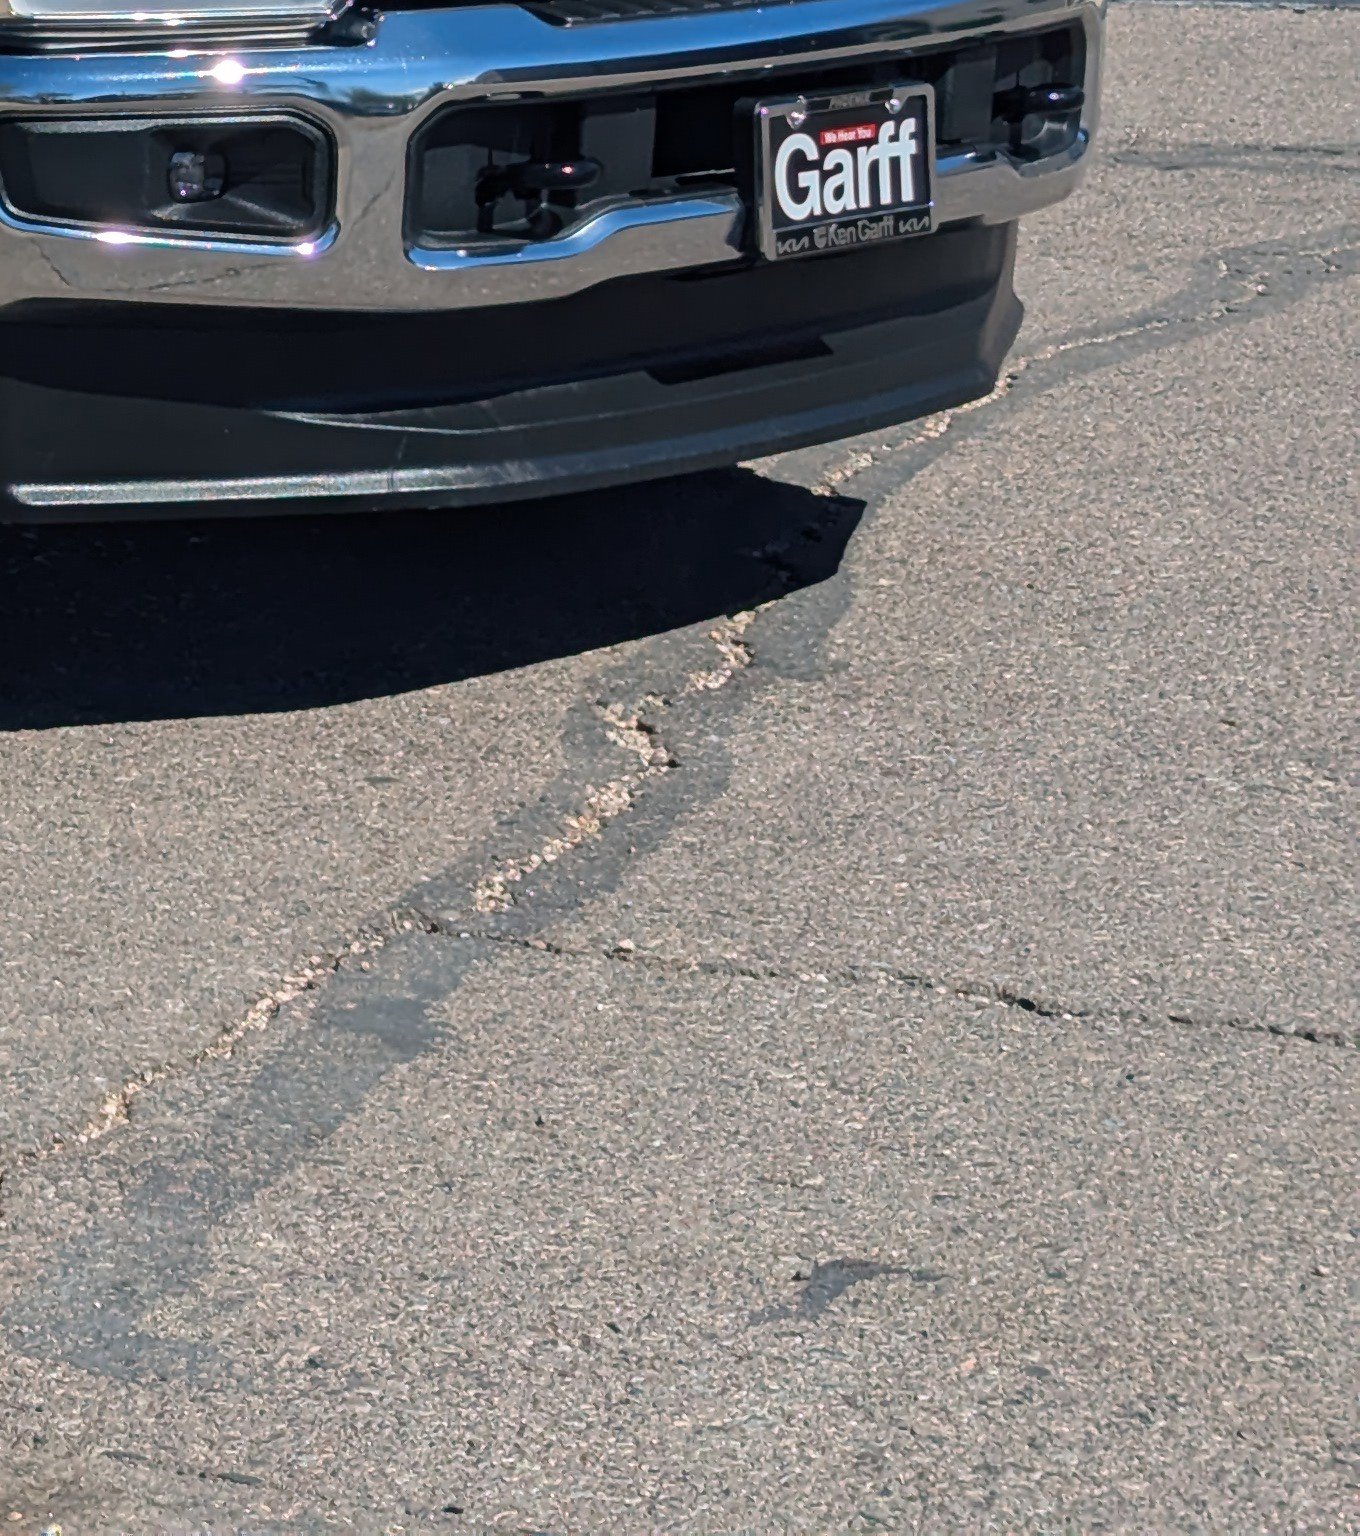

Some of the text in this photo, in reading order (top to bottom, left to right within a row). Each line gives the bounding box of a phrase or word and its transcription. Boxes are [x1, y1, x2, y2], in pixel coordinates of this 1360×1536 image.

[775, 117, 917, 221] Garff
[828, 223, 857, 246] Ken
[856, 215, 894, 242] Garff
